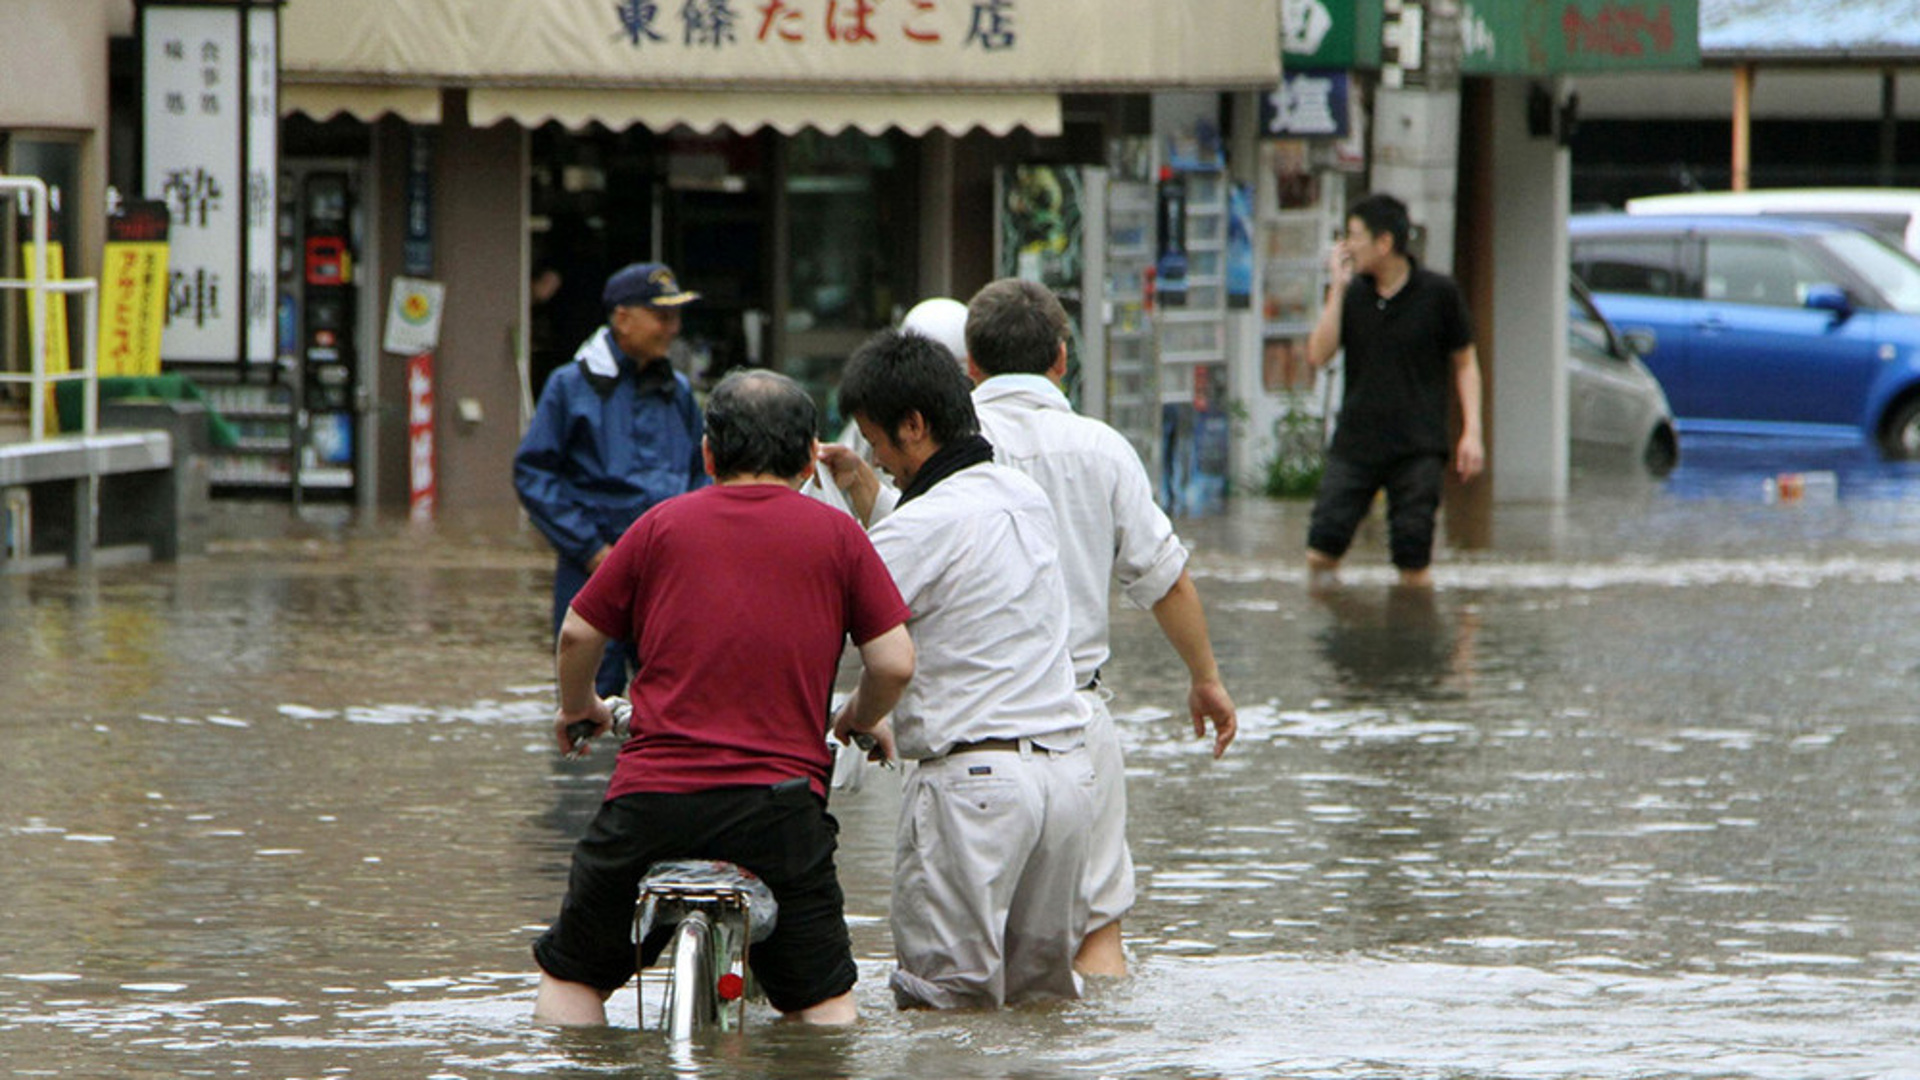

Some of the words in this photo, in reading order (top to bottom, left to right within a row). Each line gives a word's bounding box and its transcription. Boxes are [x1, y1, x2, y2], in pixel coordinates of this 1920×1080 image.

[610, 0, 1018, 51] 東條たばこ店
[1269, 73, 1337, 134] 塩
